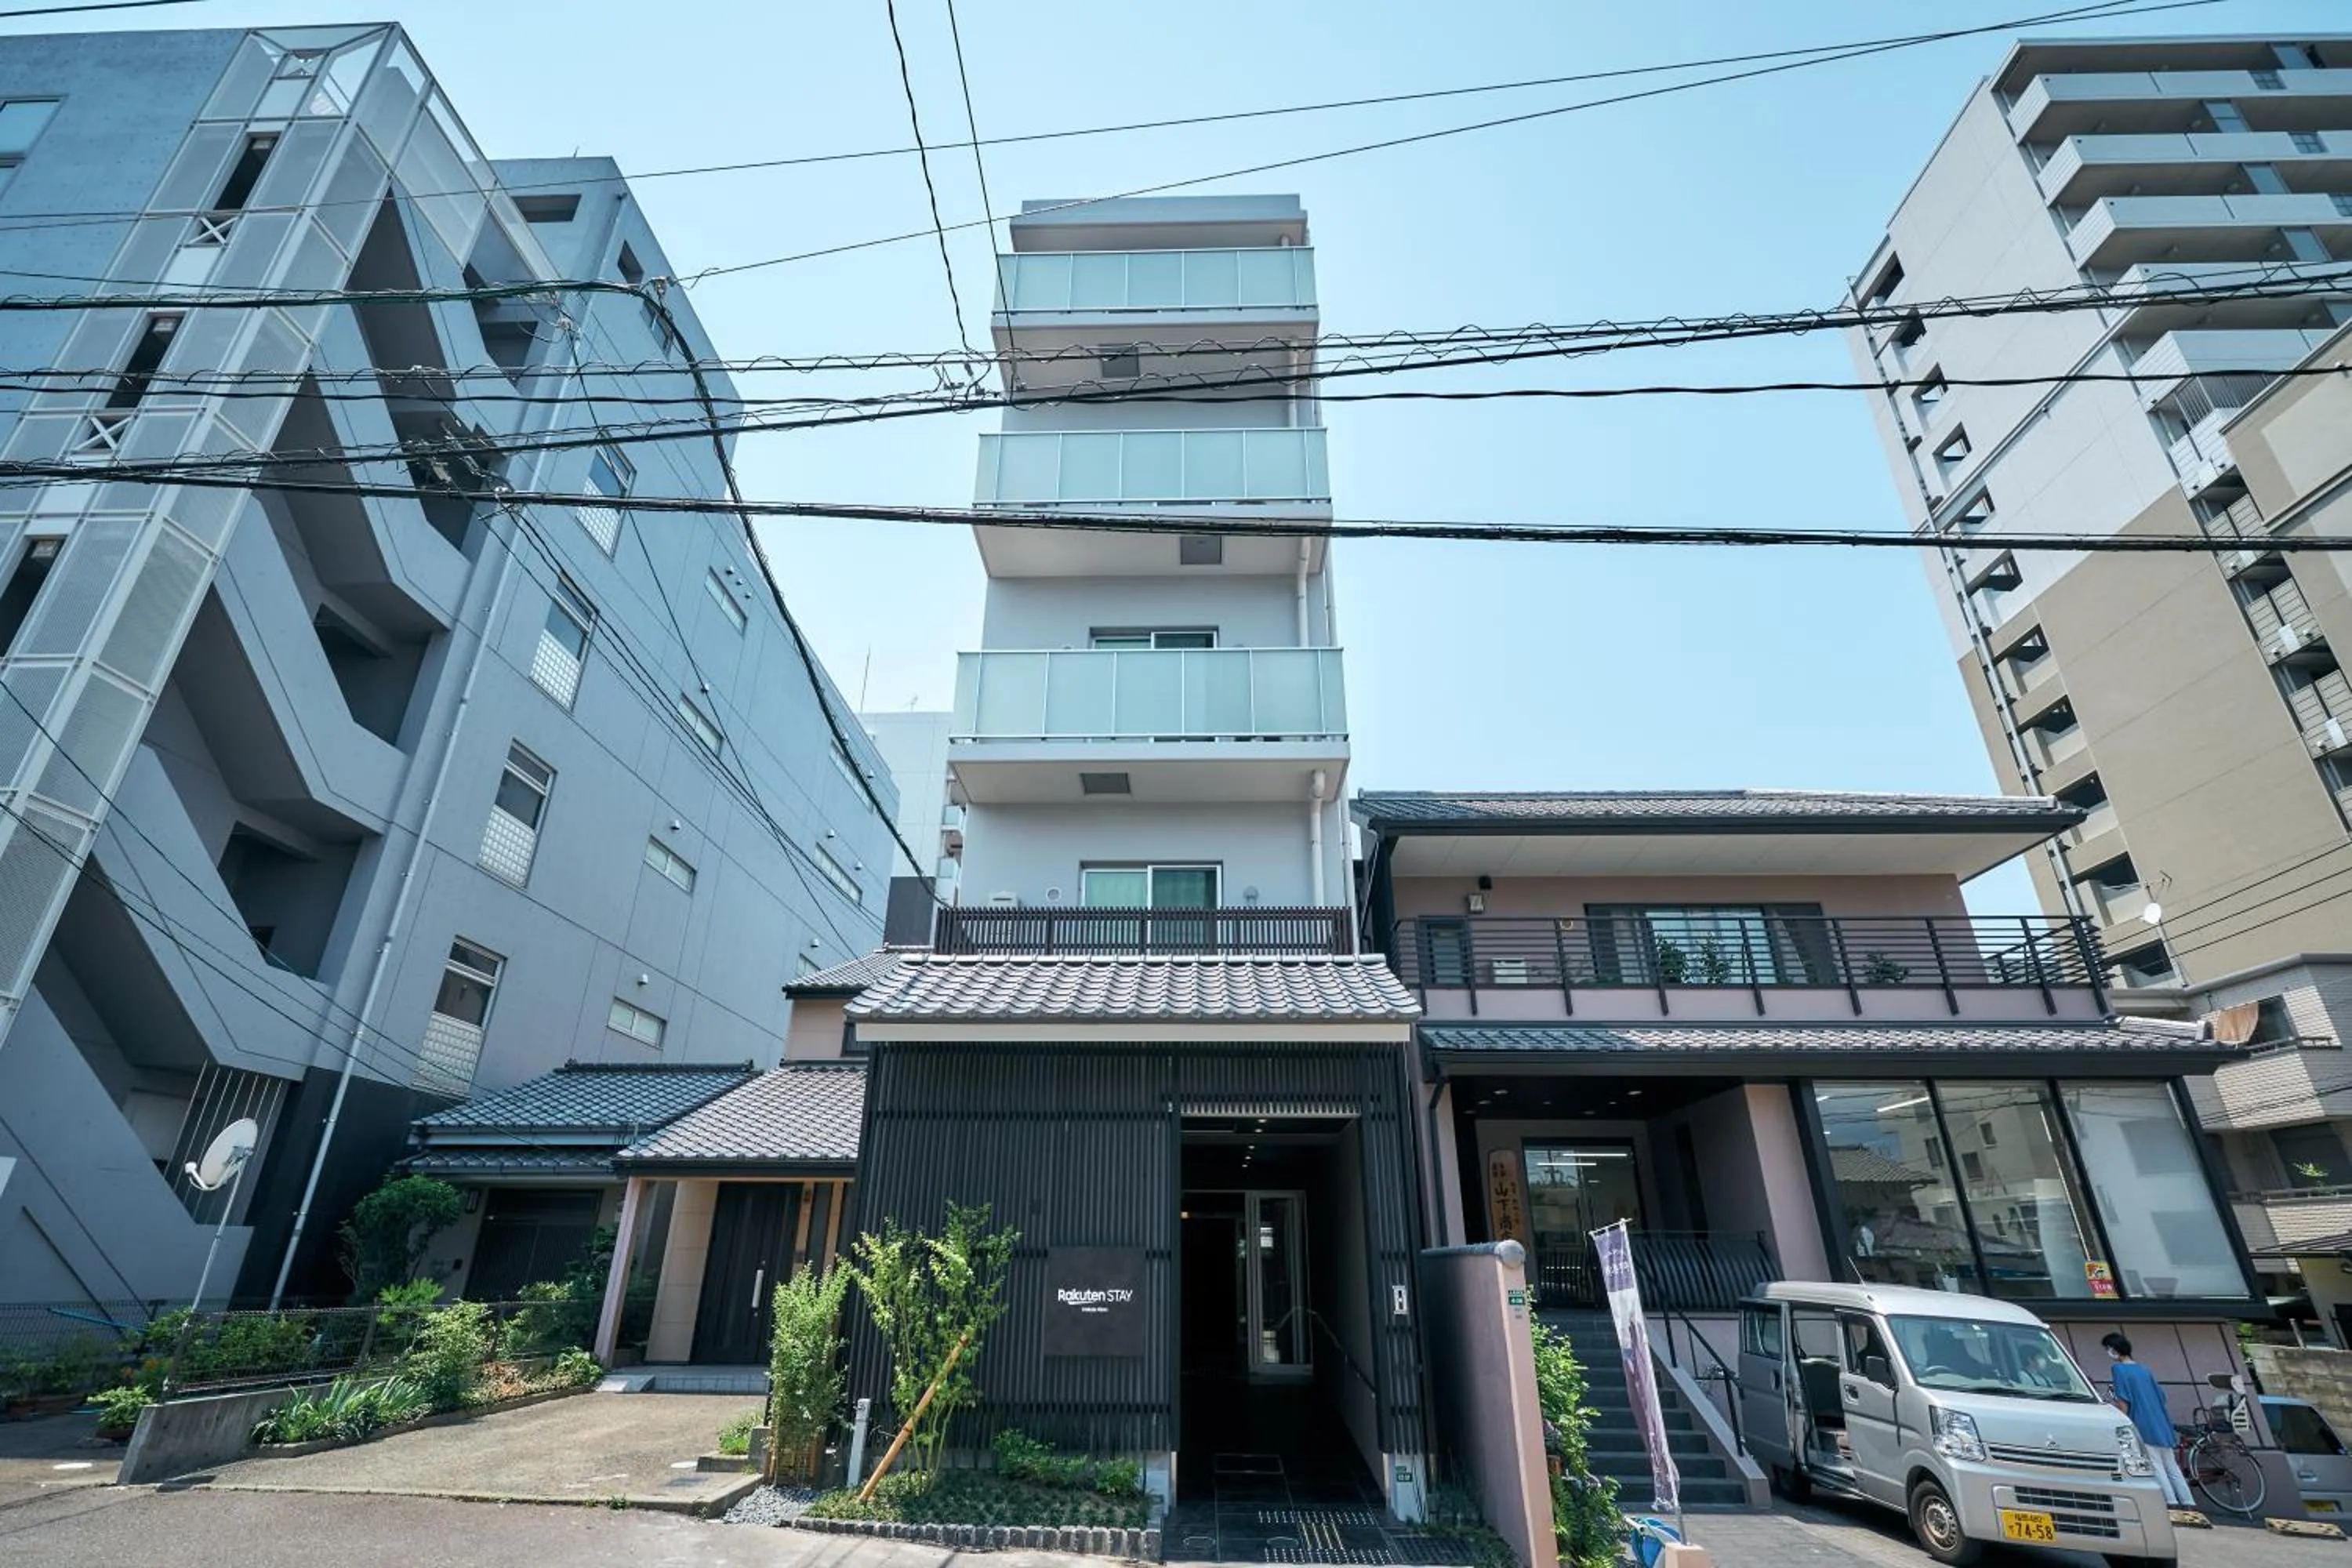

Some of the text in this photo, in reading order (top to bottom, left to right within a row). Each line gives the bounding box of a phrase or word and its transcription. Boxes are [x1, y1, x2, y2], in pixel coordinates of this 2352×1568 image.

[1058, 1288, 1133, 1305] Rakuten STAY
[2015, 1522, 2053, 1541] 74-58
